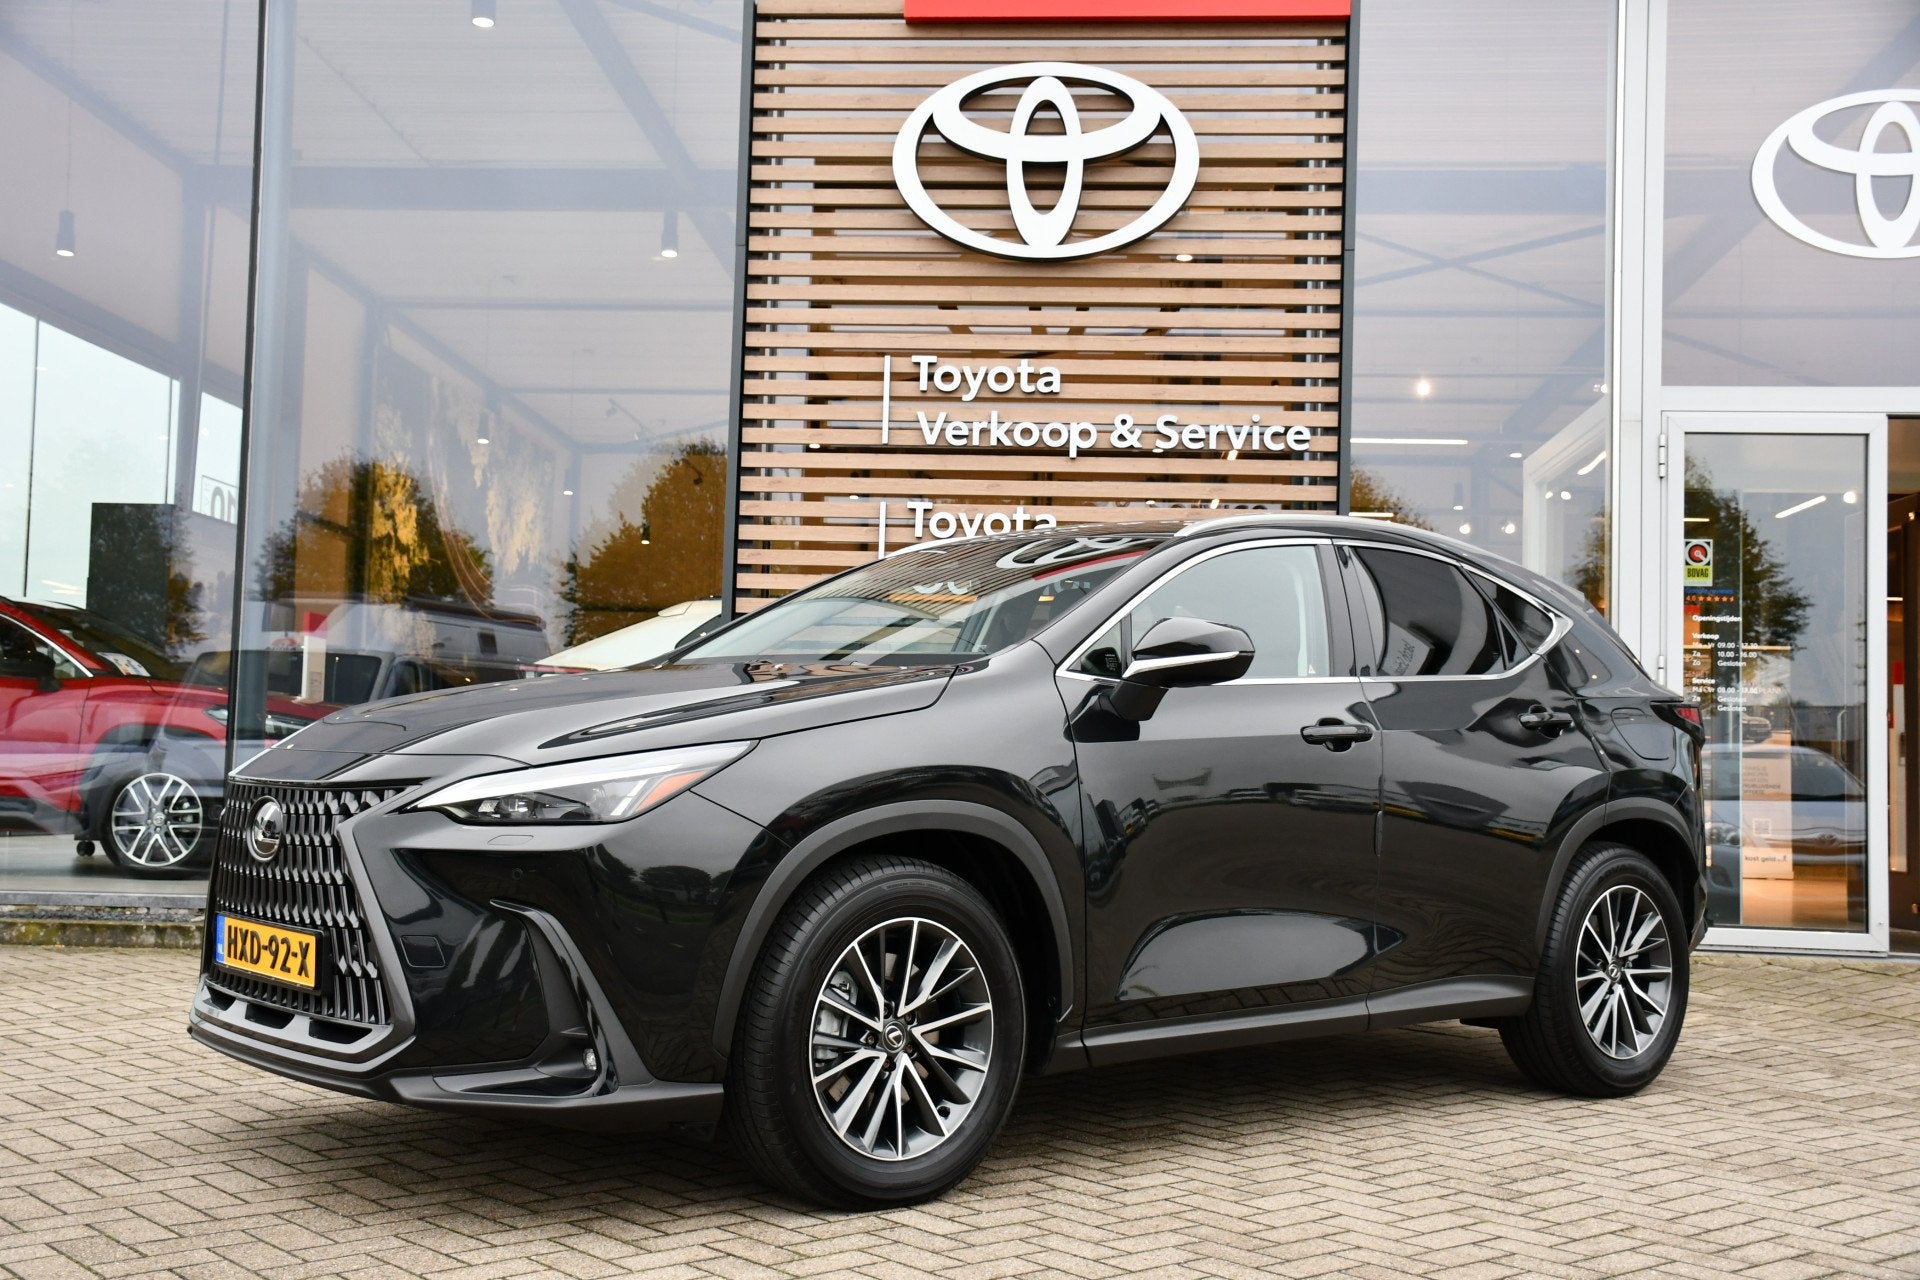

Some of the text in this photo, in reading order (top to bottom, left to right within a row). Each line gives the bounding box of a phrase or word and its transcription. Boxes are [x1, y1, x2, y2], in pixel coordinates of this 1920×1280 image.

[911, 355, 1062, 401] Toyota
[916, 410, 1311, 459] Verkoop & Service
[906, 501, 1057, 539] Toyota
[1686, 568, 1709, 578] BOVAG
[1692, 614, 1742, 623] Openingstijden
[227, 925, 310, 979] HXD-92-X
